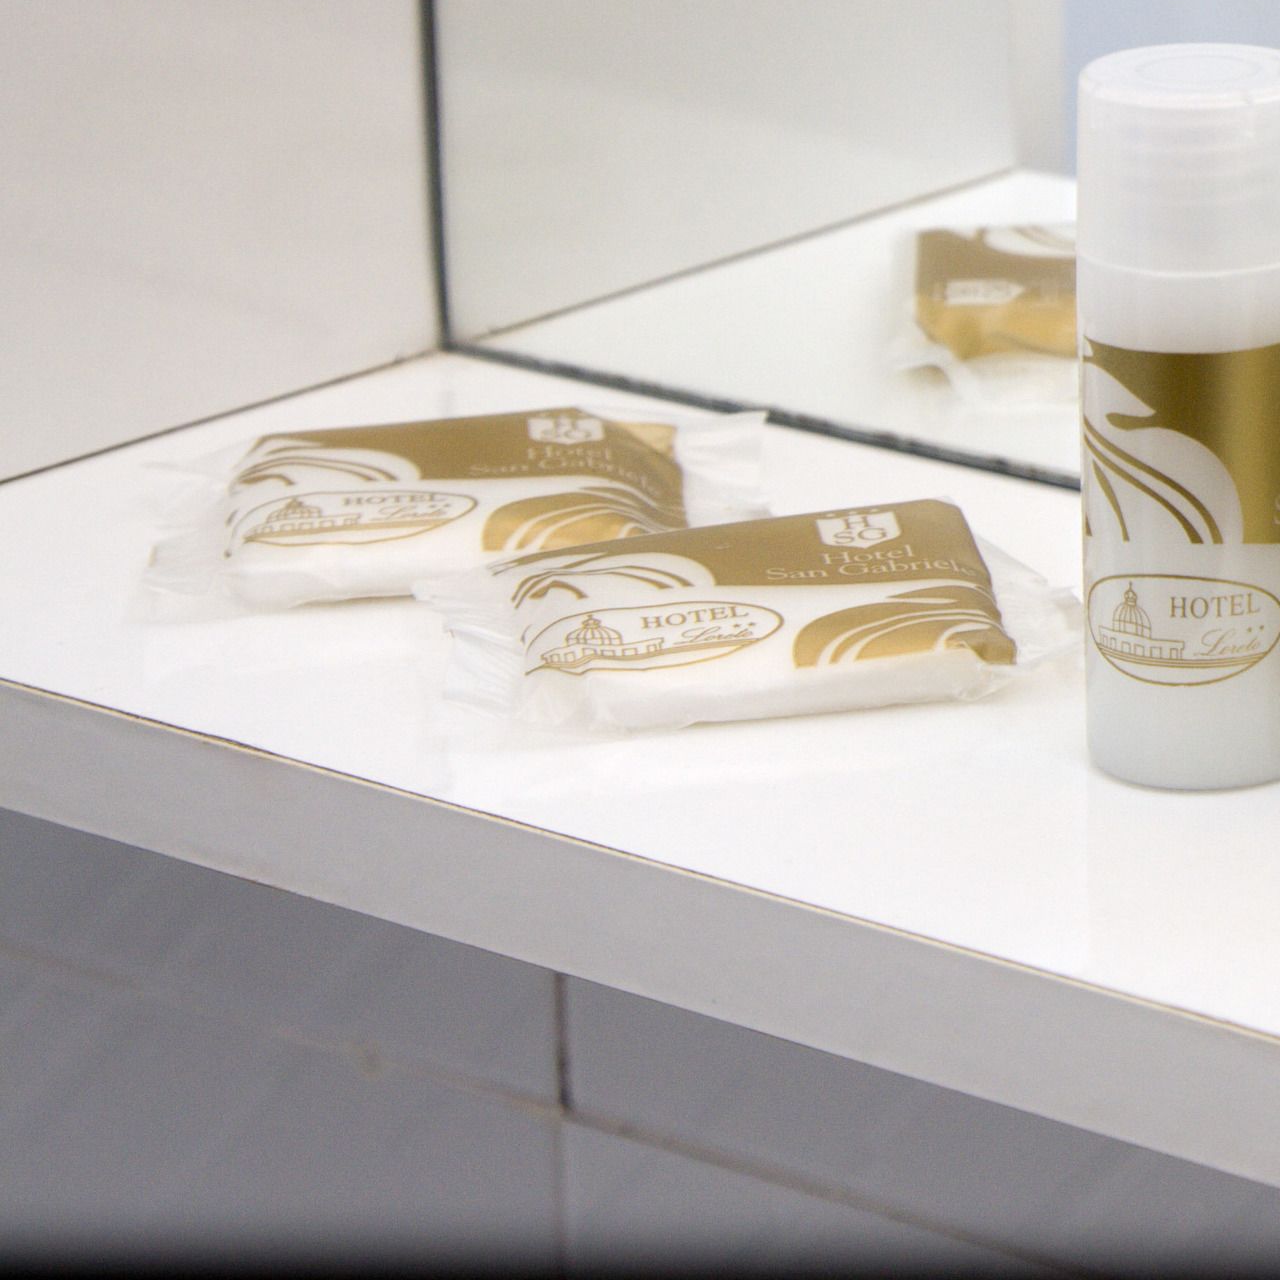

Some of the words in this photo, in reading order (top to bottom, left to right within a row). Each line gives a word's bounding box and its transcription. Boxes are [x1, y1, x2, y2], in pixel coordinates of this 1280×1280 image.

[341, 492, 451, 507] HOTEL
[833, 527, 888, 546] SG
[822, 544, 915, 565] Hotel
[766, 565, 827, 581] San
[839, 558, 977, 578] Gabriele
[1169, 592, 1261, 620] HOTEL
[641, 605, 750, 630] HOTEL
